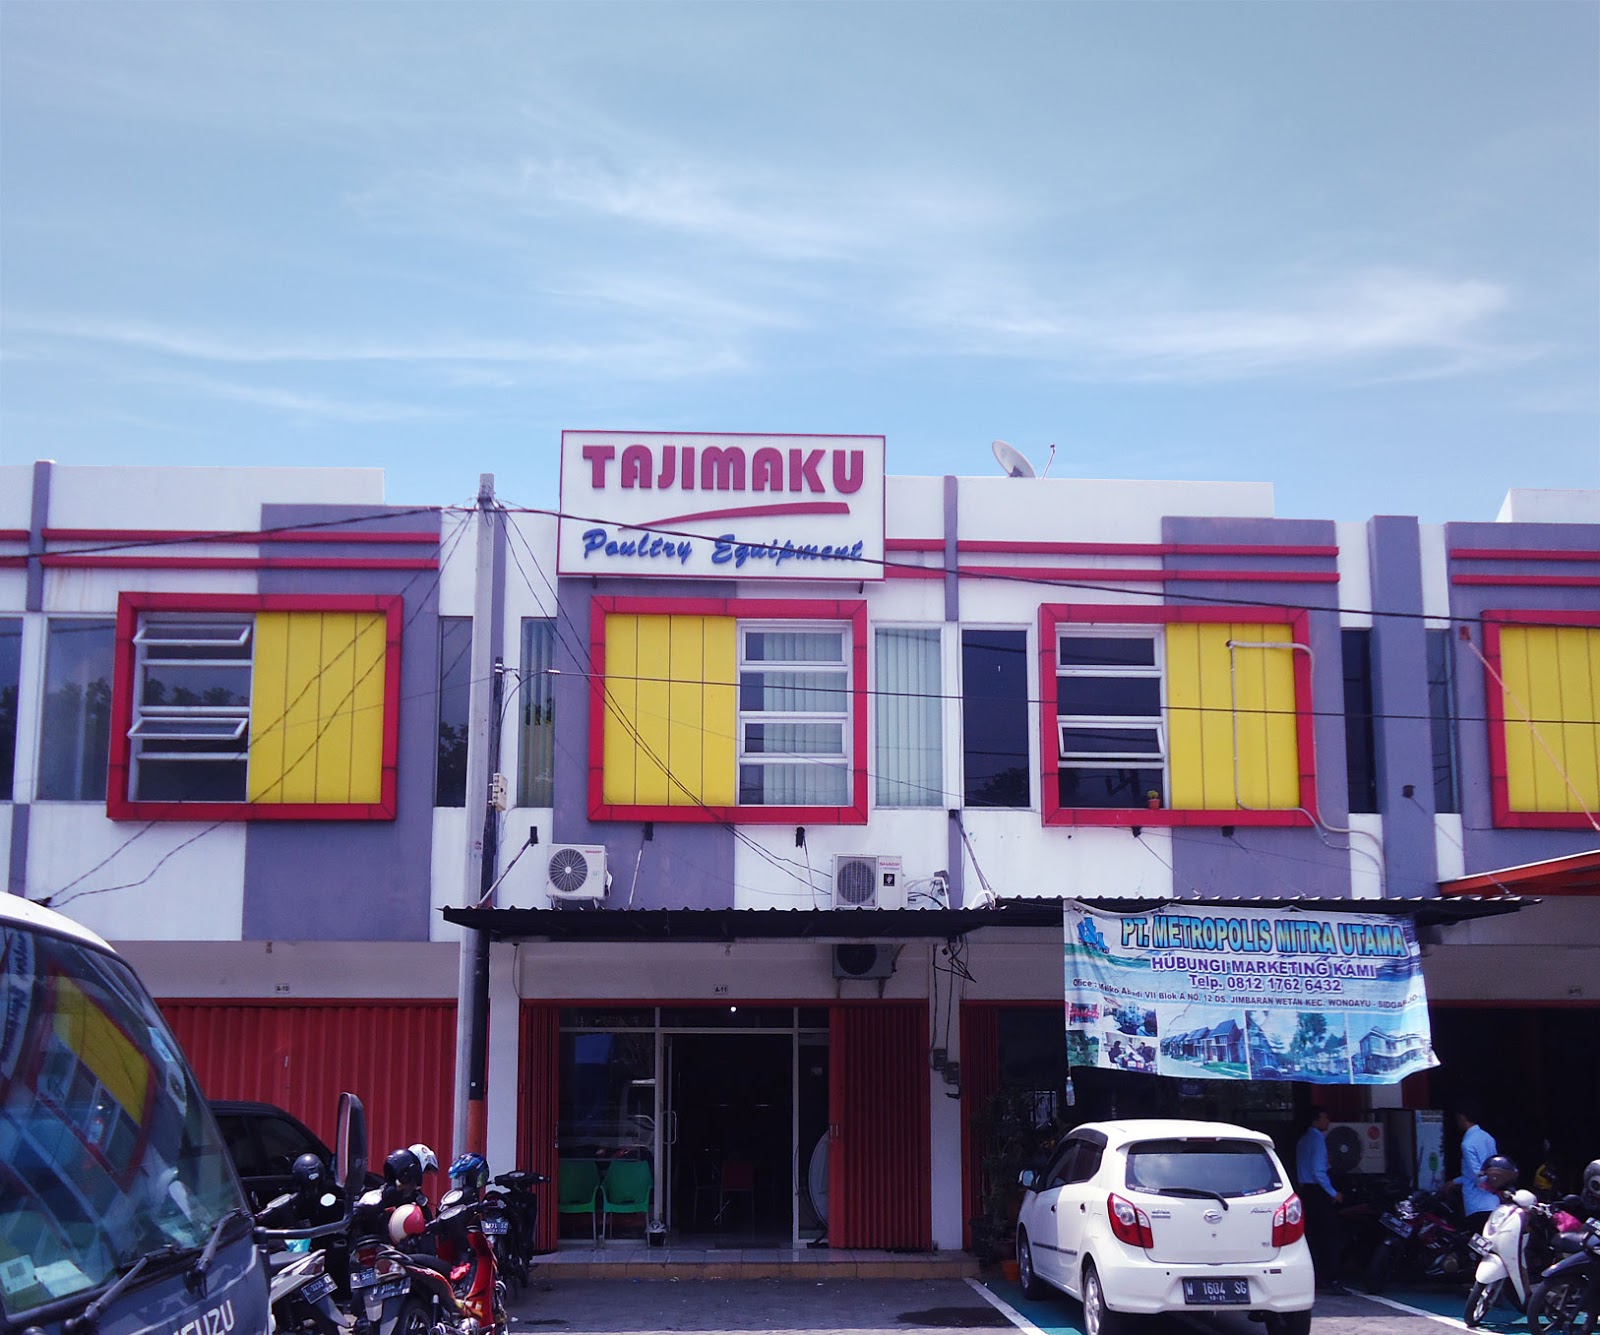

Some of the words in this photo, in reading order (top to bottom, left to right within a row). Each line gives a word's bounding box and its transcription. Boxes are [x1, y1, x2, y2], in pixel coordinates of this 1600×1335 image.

[582, 444, 864, 494] TAJIMAKU
[711, 534, 863, 568] Equipment
[1120, 917, 1150, 947] PT.
[1152, 915, 1272, 953] METROPOLIS
[1274, 919, 1338, 954] MITRA
[1337, 922, 1408, 957] UTAMA
[1152, 956, 1226, 972] HUBUNGI
[1231, 959, 1329, 976] MARKETING
[1334, 962, 1375, 978] KAMI
[1189, 974, 1223, 990] Telp.
[1227, 976, 1263, 989] 0812
[1268, 977, 1301, 990] 1762
[1305, 978, 1341, 991] 6432
[1159, 992, 1177, 1000] Blok
[1179, 992, 1186, 1000] A
[1203, 994, 1213, 1002] 12
[1230, 996, 1273, 1005] JIMBARAN
[1275, 998, 1303, 1006] WETAN
[1305, 998, 1325, 1007] KEC.
[1185, 1283, 1194, 1295] W
[1202, 1282, 1226, 1295] 1604
[1234, 1282, 1247, 1294] SG
[173, 1300, 235, 1335] UZU
